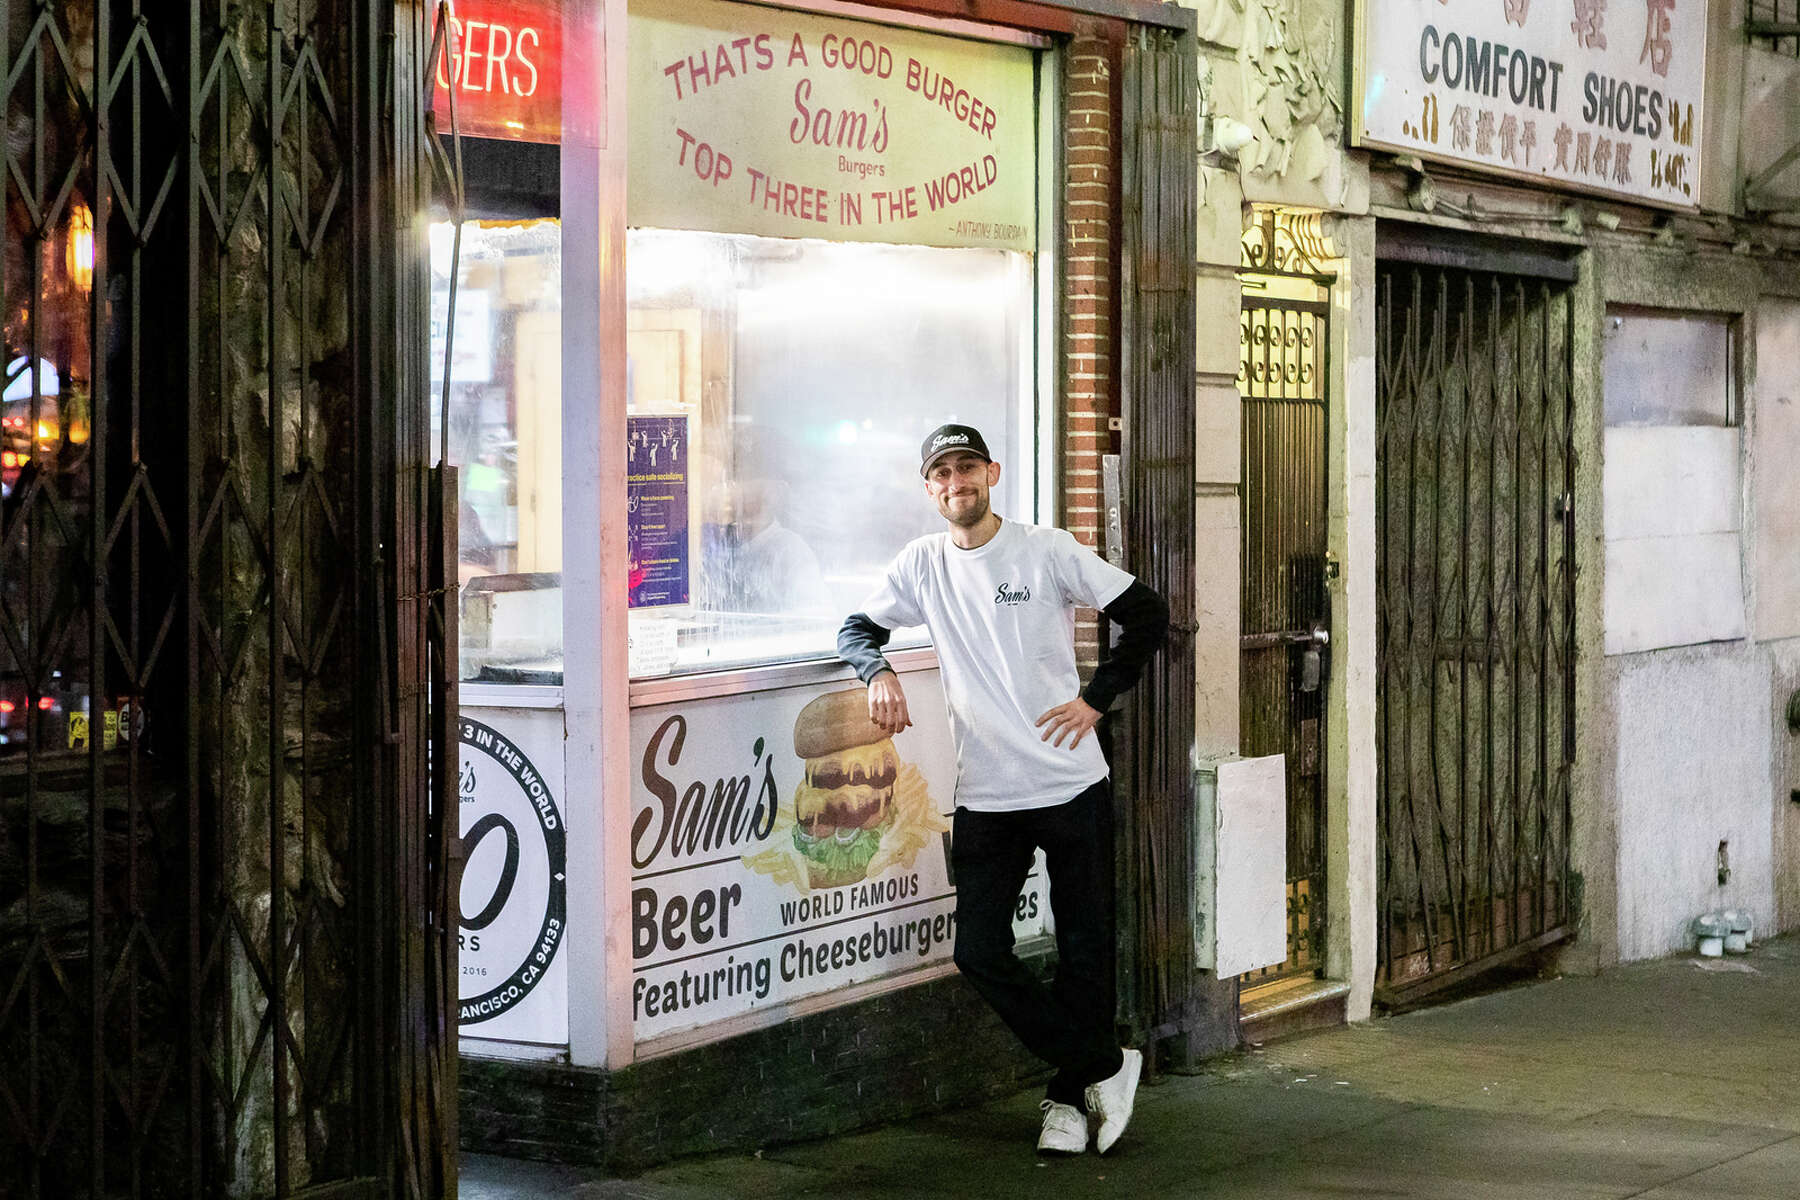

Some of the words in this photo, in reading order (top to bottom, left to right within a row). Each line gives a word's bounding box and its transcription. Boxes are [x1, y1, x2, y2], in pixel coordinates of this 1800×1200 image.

[432, 17, 539, 96] GERS
[664, 34, 773, 100] THATS
[788, 32, 808, 67] A
[822, 33, 892, 79] GOOD
[906, 58, 996, 140] BURGER
[1420, 24, 1563, 113] COMFORT
[1583, 72, 1663, 140] SHOES
[790, 78, 888, 153] Sam's
[676, 128, 733, 187] TOP
[747, 167, 828, 223] THREE
[840, 192, 862, 225] IN
[872, 186, 918, 224] THE
[924, 154, 997, 212] WORLD
[838, 155, 885, 180] Burgers
[930, 433, 969, 452] Sam's
[994, 582, 1031, 604] Sam's
[463, 724, 474, 739] 3
[476, 729, 494, 748] IN
[495, 740, 523, 771] THE
[521, 766, 557, 830] WORLD
[631, 715, 777, 869] Sam's
[632, 883, 741, 959] Beer
[780, 890, 843, 927] WORLD
[851, 873, 918, 910] FAMOUS
[459, 986, 523, 1019] ANCISCO,
[522, 965, 540, 985] CA
[536, 918, 560, 963] 94133
[463, 967, 487, 976] 2016
[633, 956, 771, 1021] featuring
